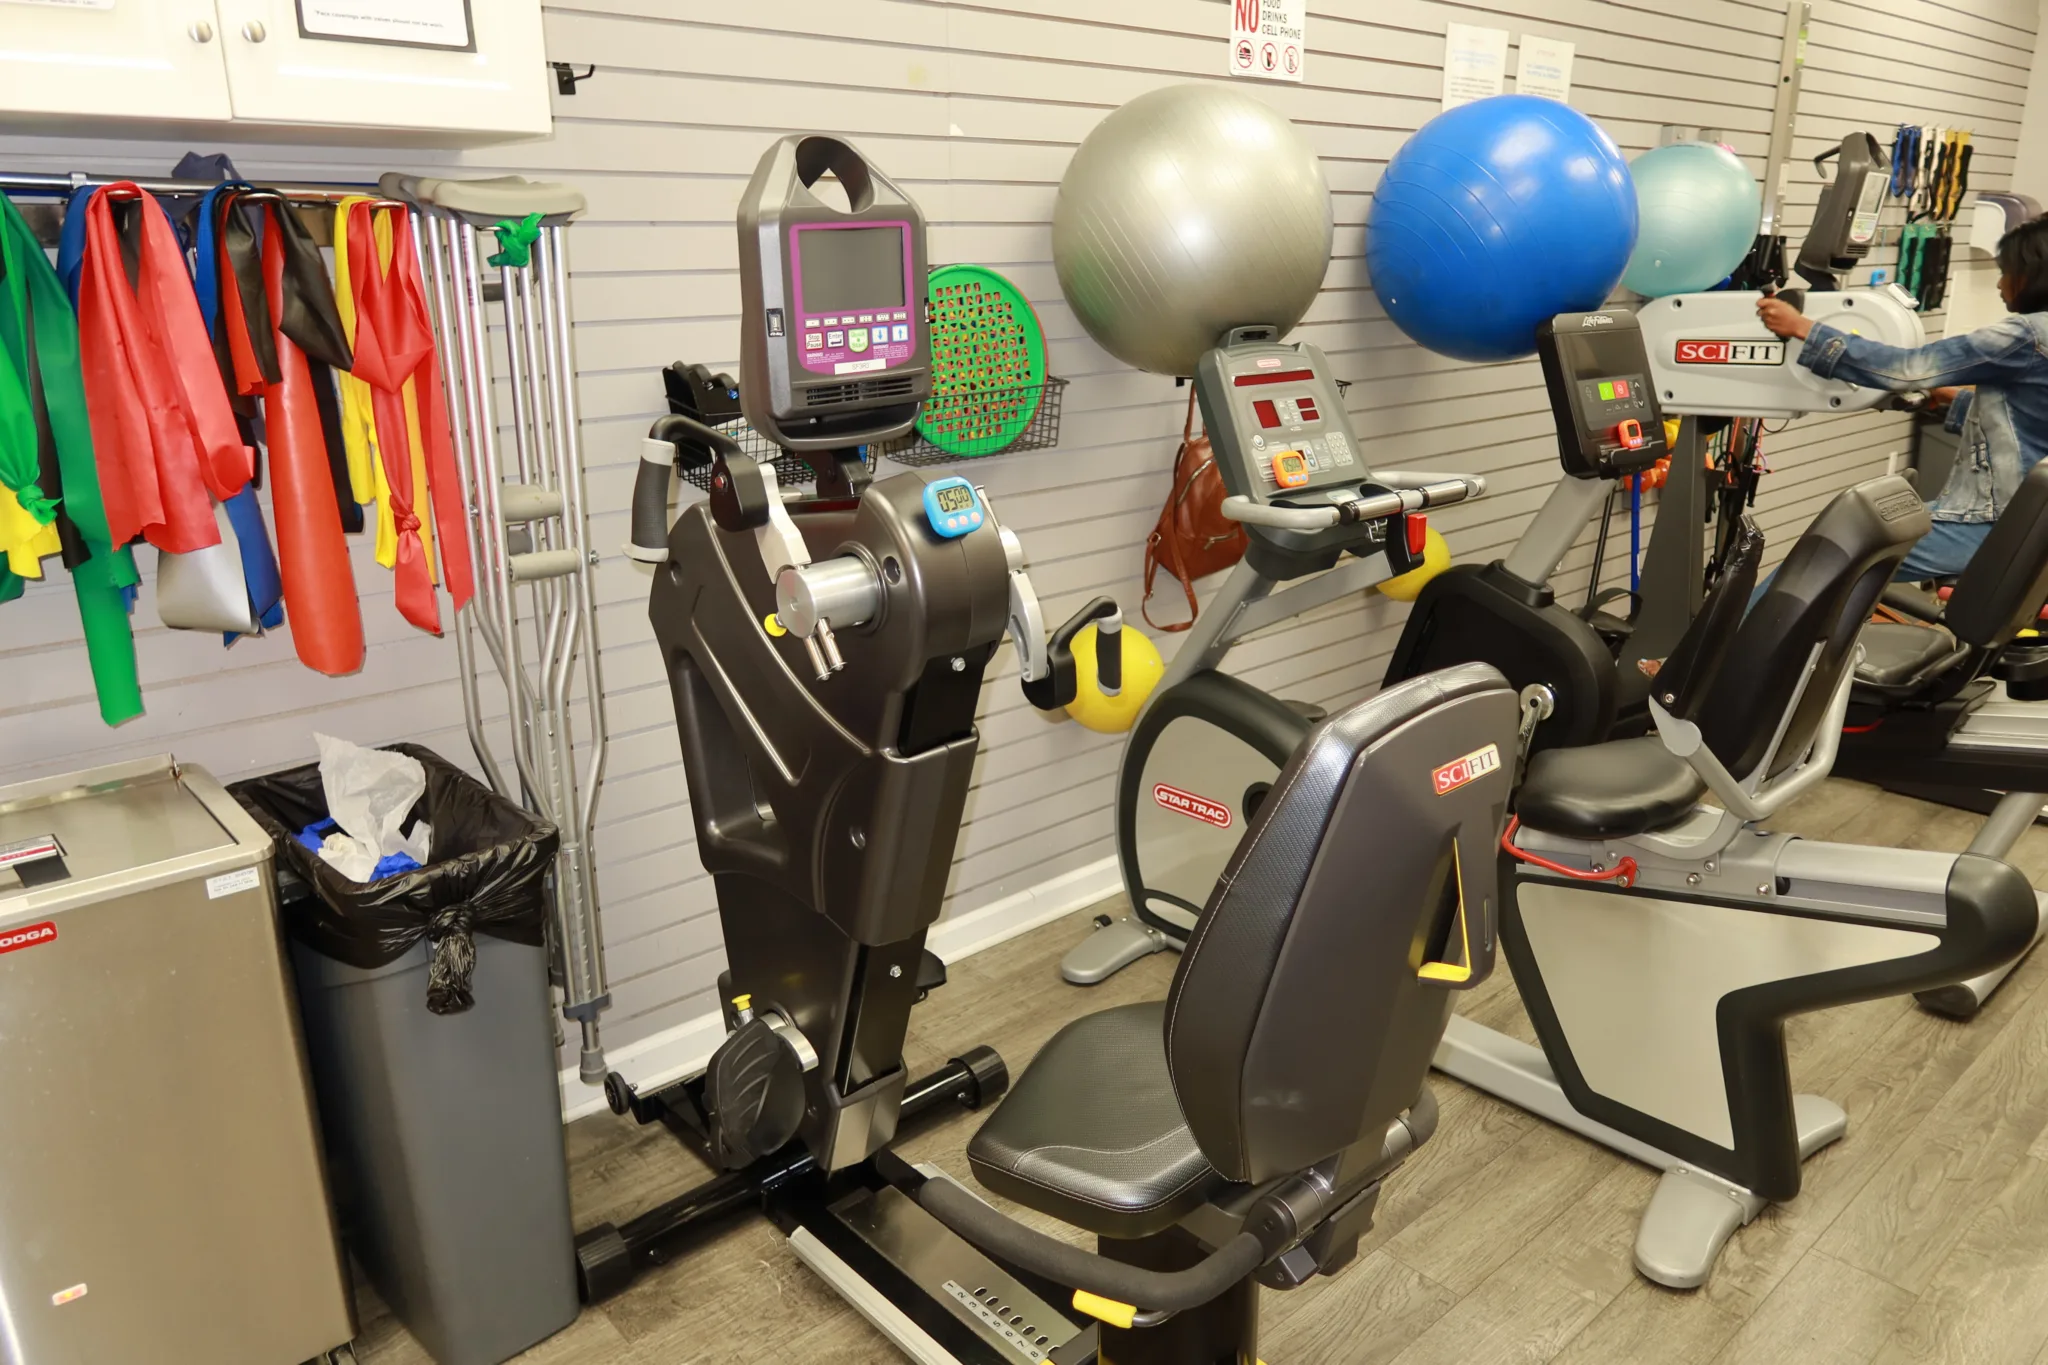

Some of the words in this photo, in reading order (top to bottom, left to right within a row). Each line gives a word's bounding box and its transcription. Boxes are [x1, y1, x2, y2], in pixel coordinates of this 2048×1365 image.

[1262, 0, 1281, 9] FOOD
[1235, 0, 1259, 33] NO
[1262, 10, 1288, 24] DRINKS
[1262, 24, 1278, 36] CELL
[1280, 27, 1301, 39] PHONE
[1681, 343, 1780, 361] SCIFIT
[1438, 750, 1495, 789] SCIFIT
[1158, 790, 1190, 808] STAR
[1191, 801, 1225, 820] TRAC
[1030, 1350, 1039, 1358] 8
